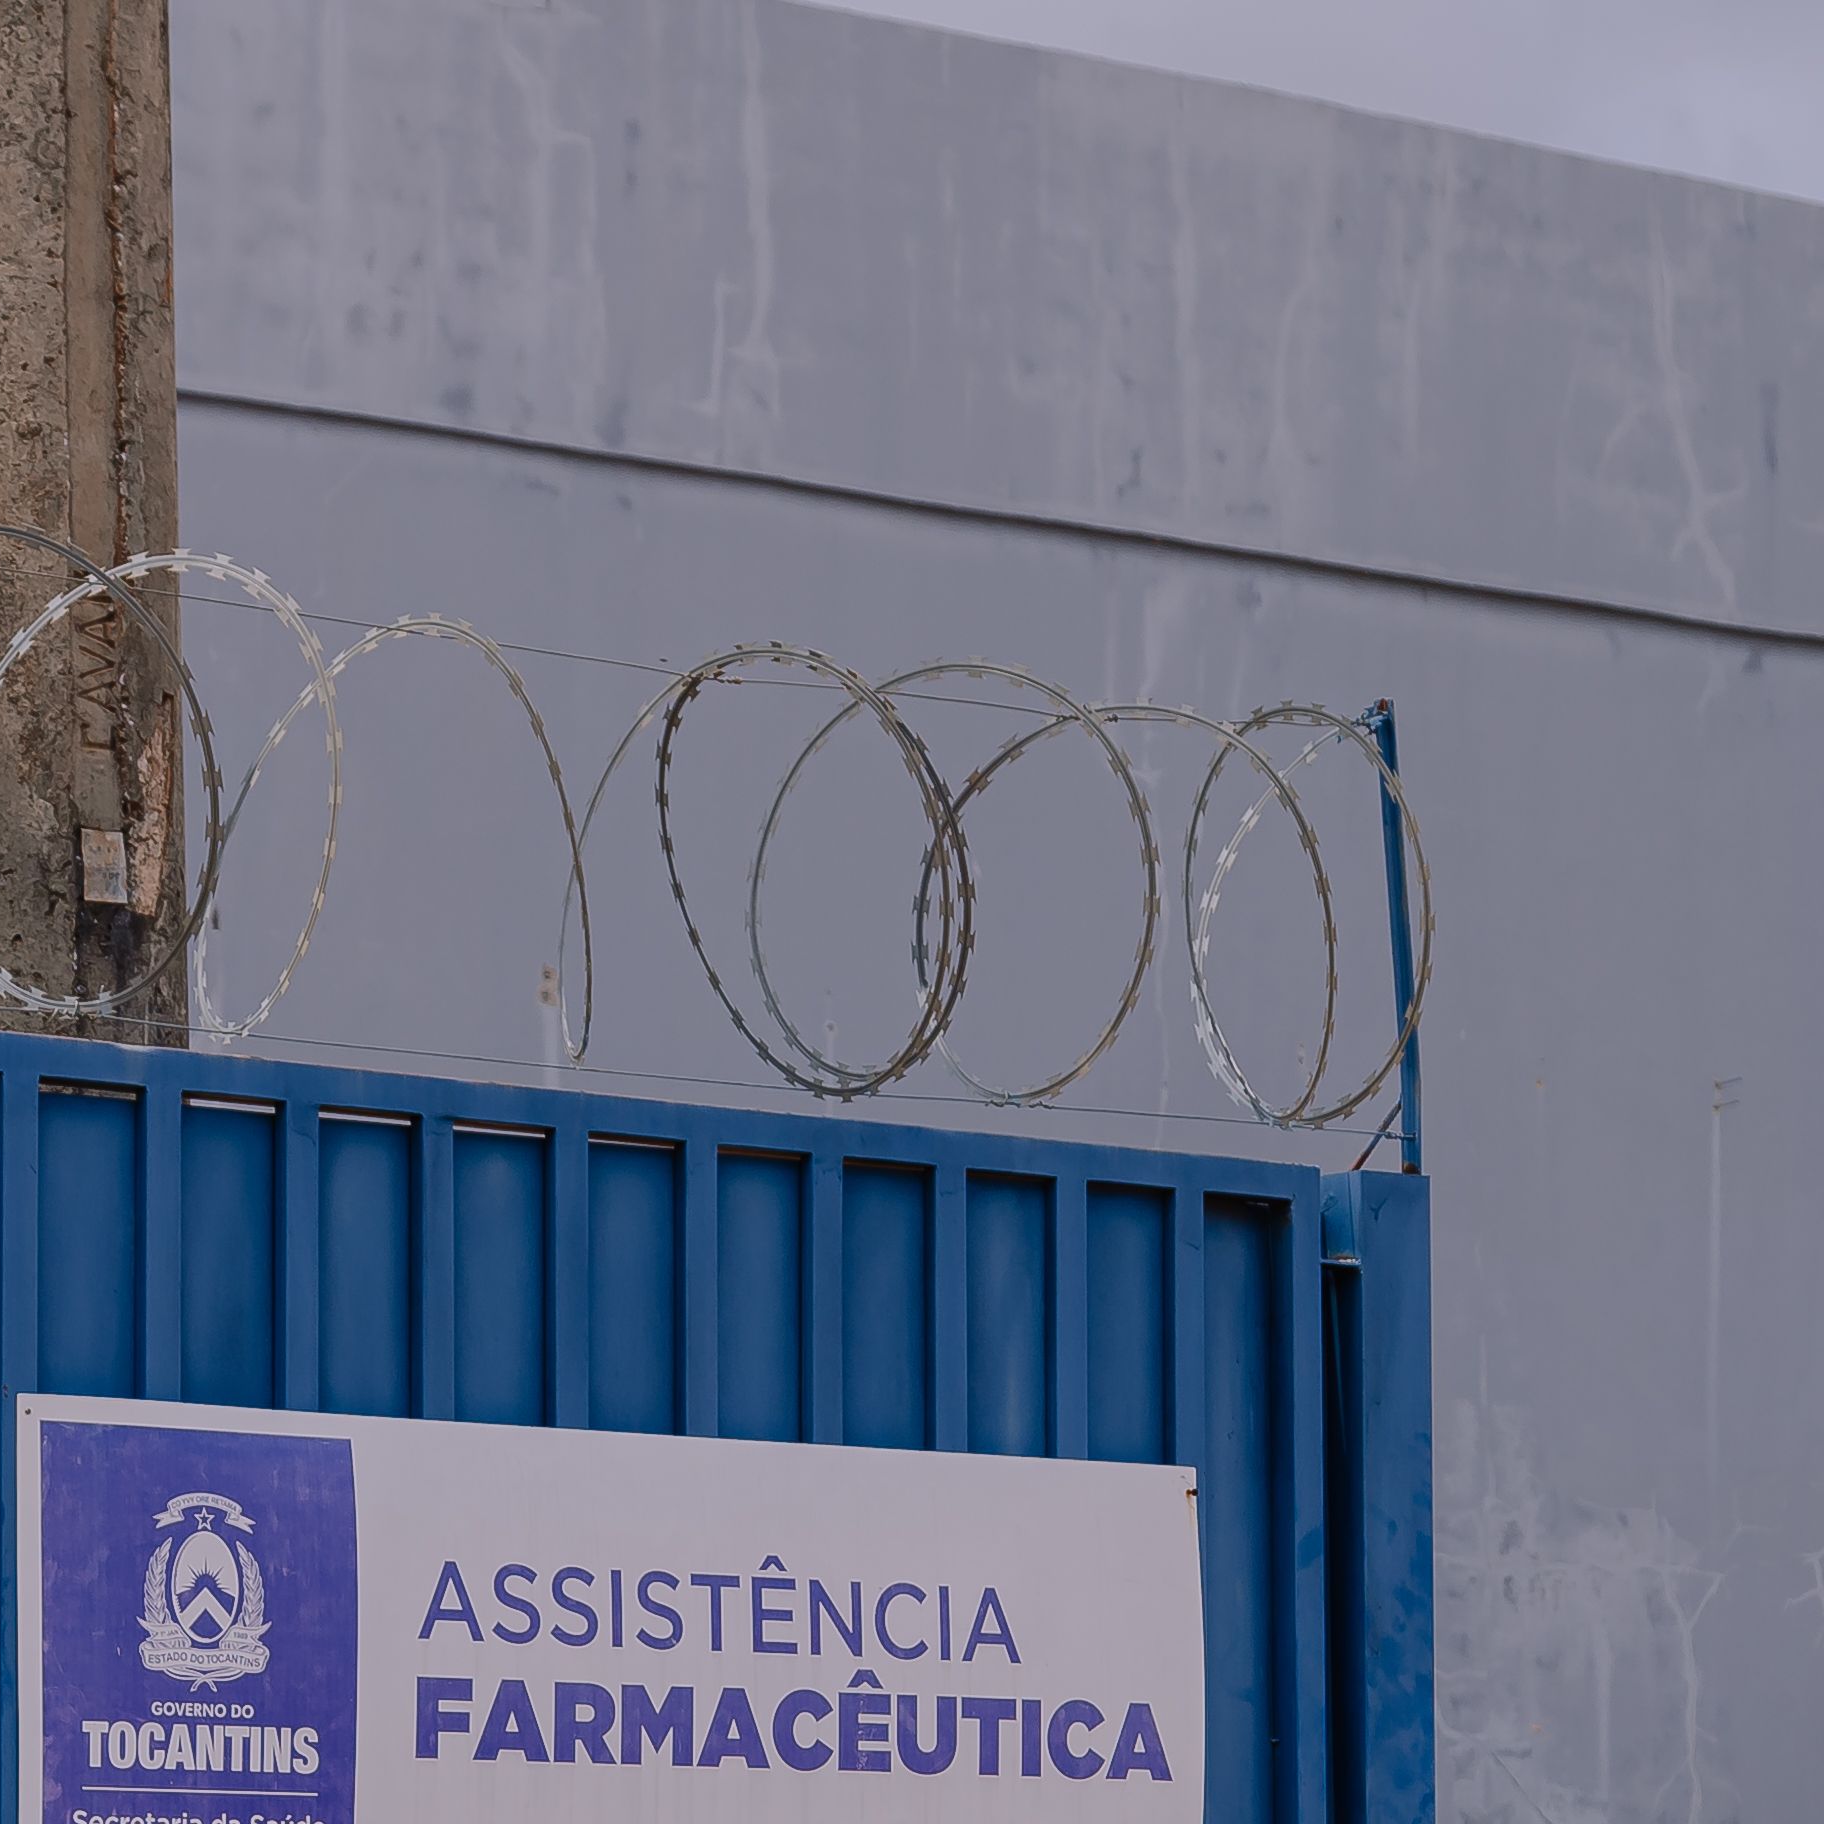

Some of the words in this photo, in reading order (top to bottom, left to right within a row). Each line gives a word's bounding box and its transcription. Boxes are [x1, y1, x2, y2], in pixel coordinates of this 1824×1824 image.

[418, 1555, 1022, 1664] ASSISTÊNCIA
[148, 1651, 187, 1664] ESTADO
[190, 1653, 204, 1665] DO
[206, 1654, 261, 1668] TOCANTINS
[151, 1701, 227, 1718] GOVERNO
[231, 1704, 254, 1719] DO
[415, 1668, 1174, 1783] FARMACÊUTICA
[82, 1720, 319, 1774] TOCANTINS
